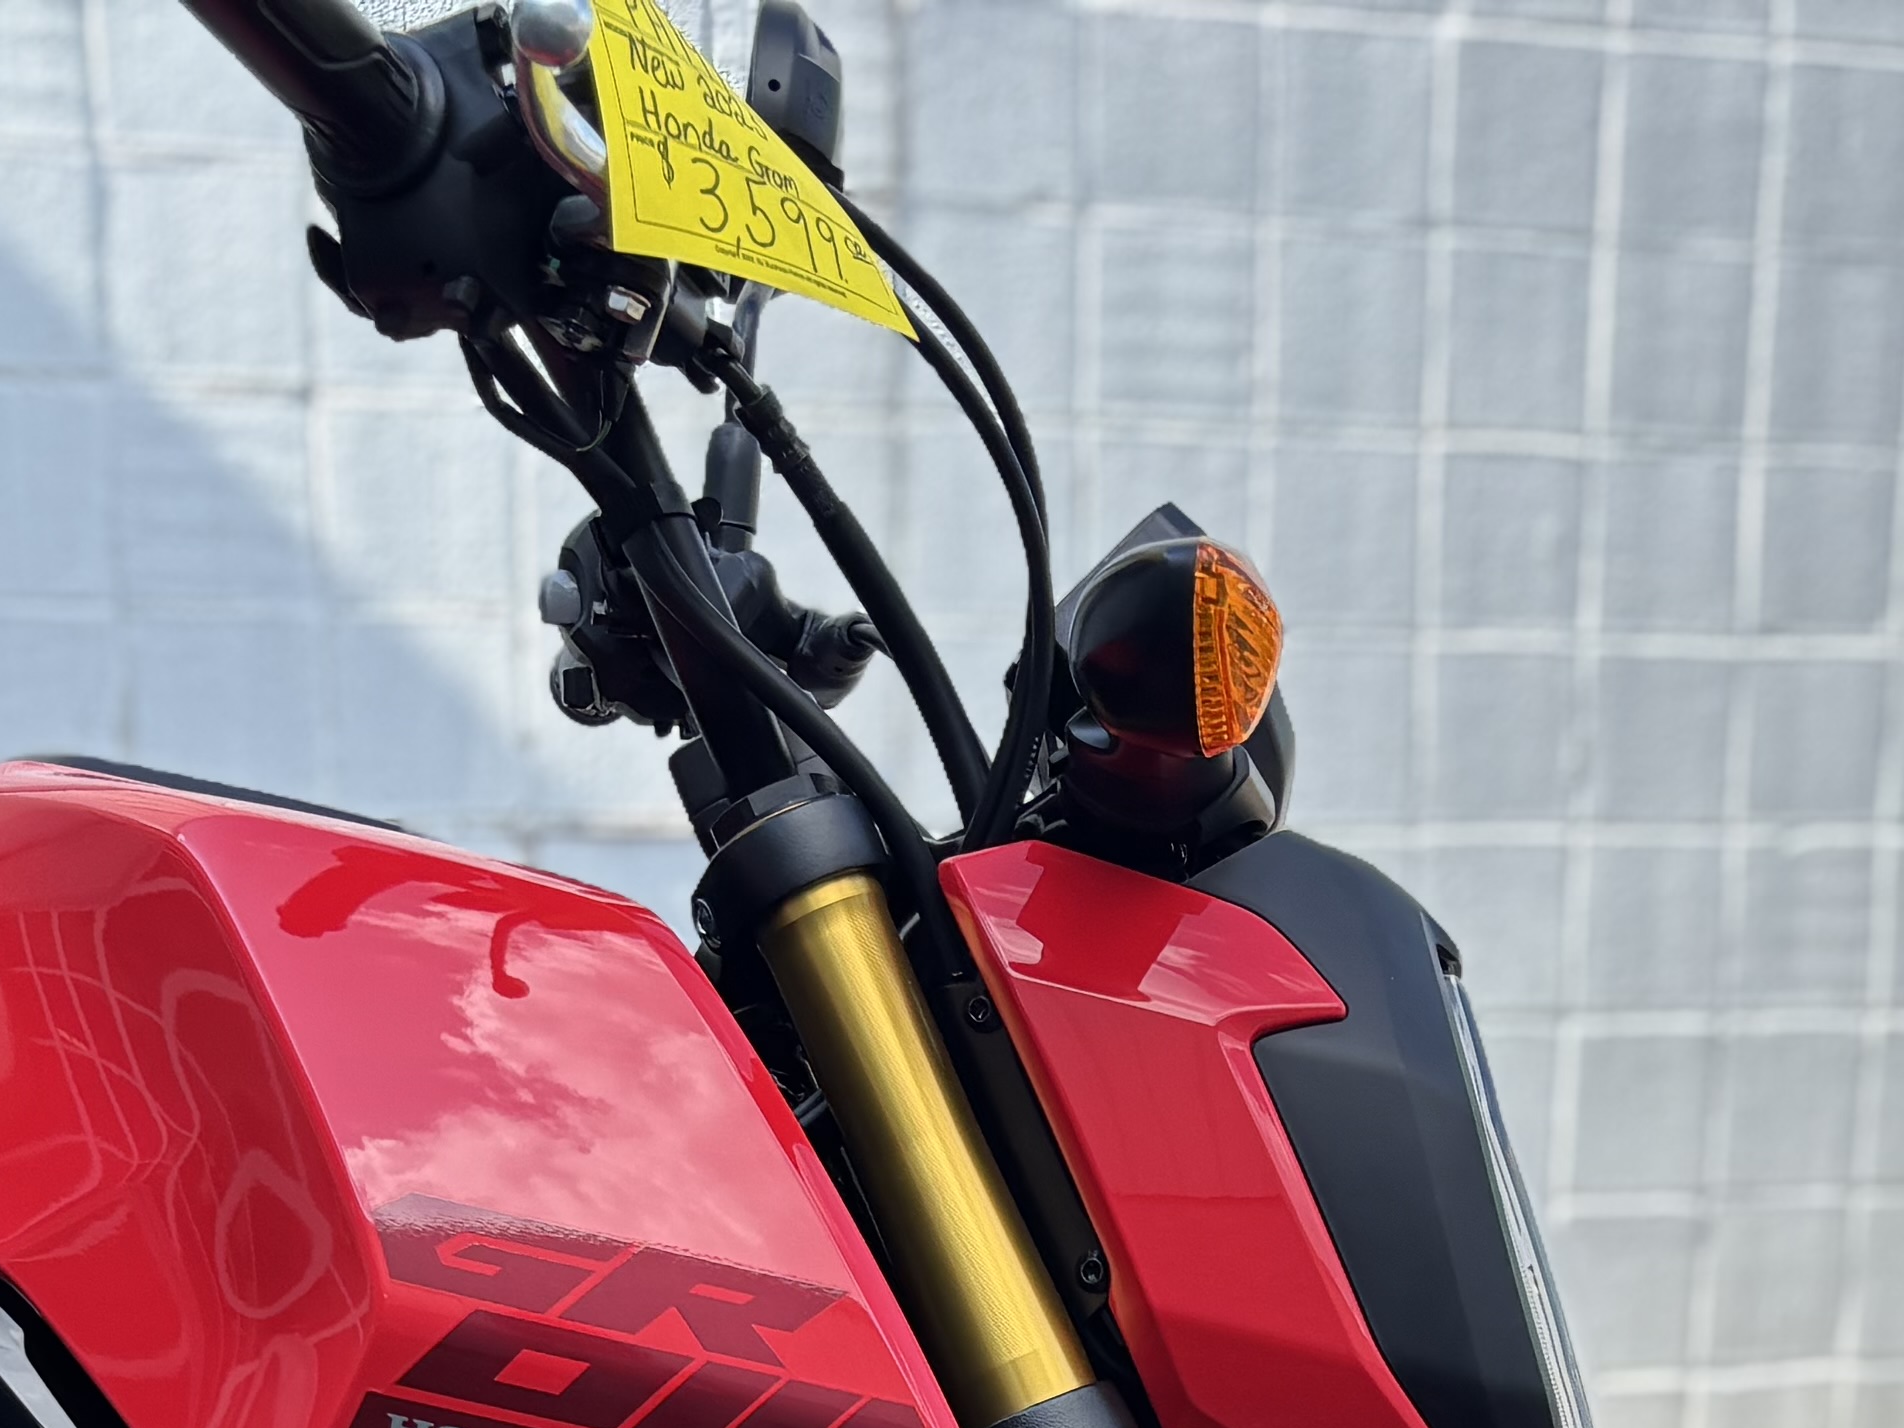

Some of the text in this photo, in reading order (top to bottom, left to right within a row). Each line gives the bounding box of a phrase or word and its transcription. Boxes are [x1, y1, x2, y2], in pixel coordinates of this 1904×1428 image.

[627, 31, 685, 91] New
[638, 85, 801, 200] Honda Grom
